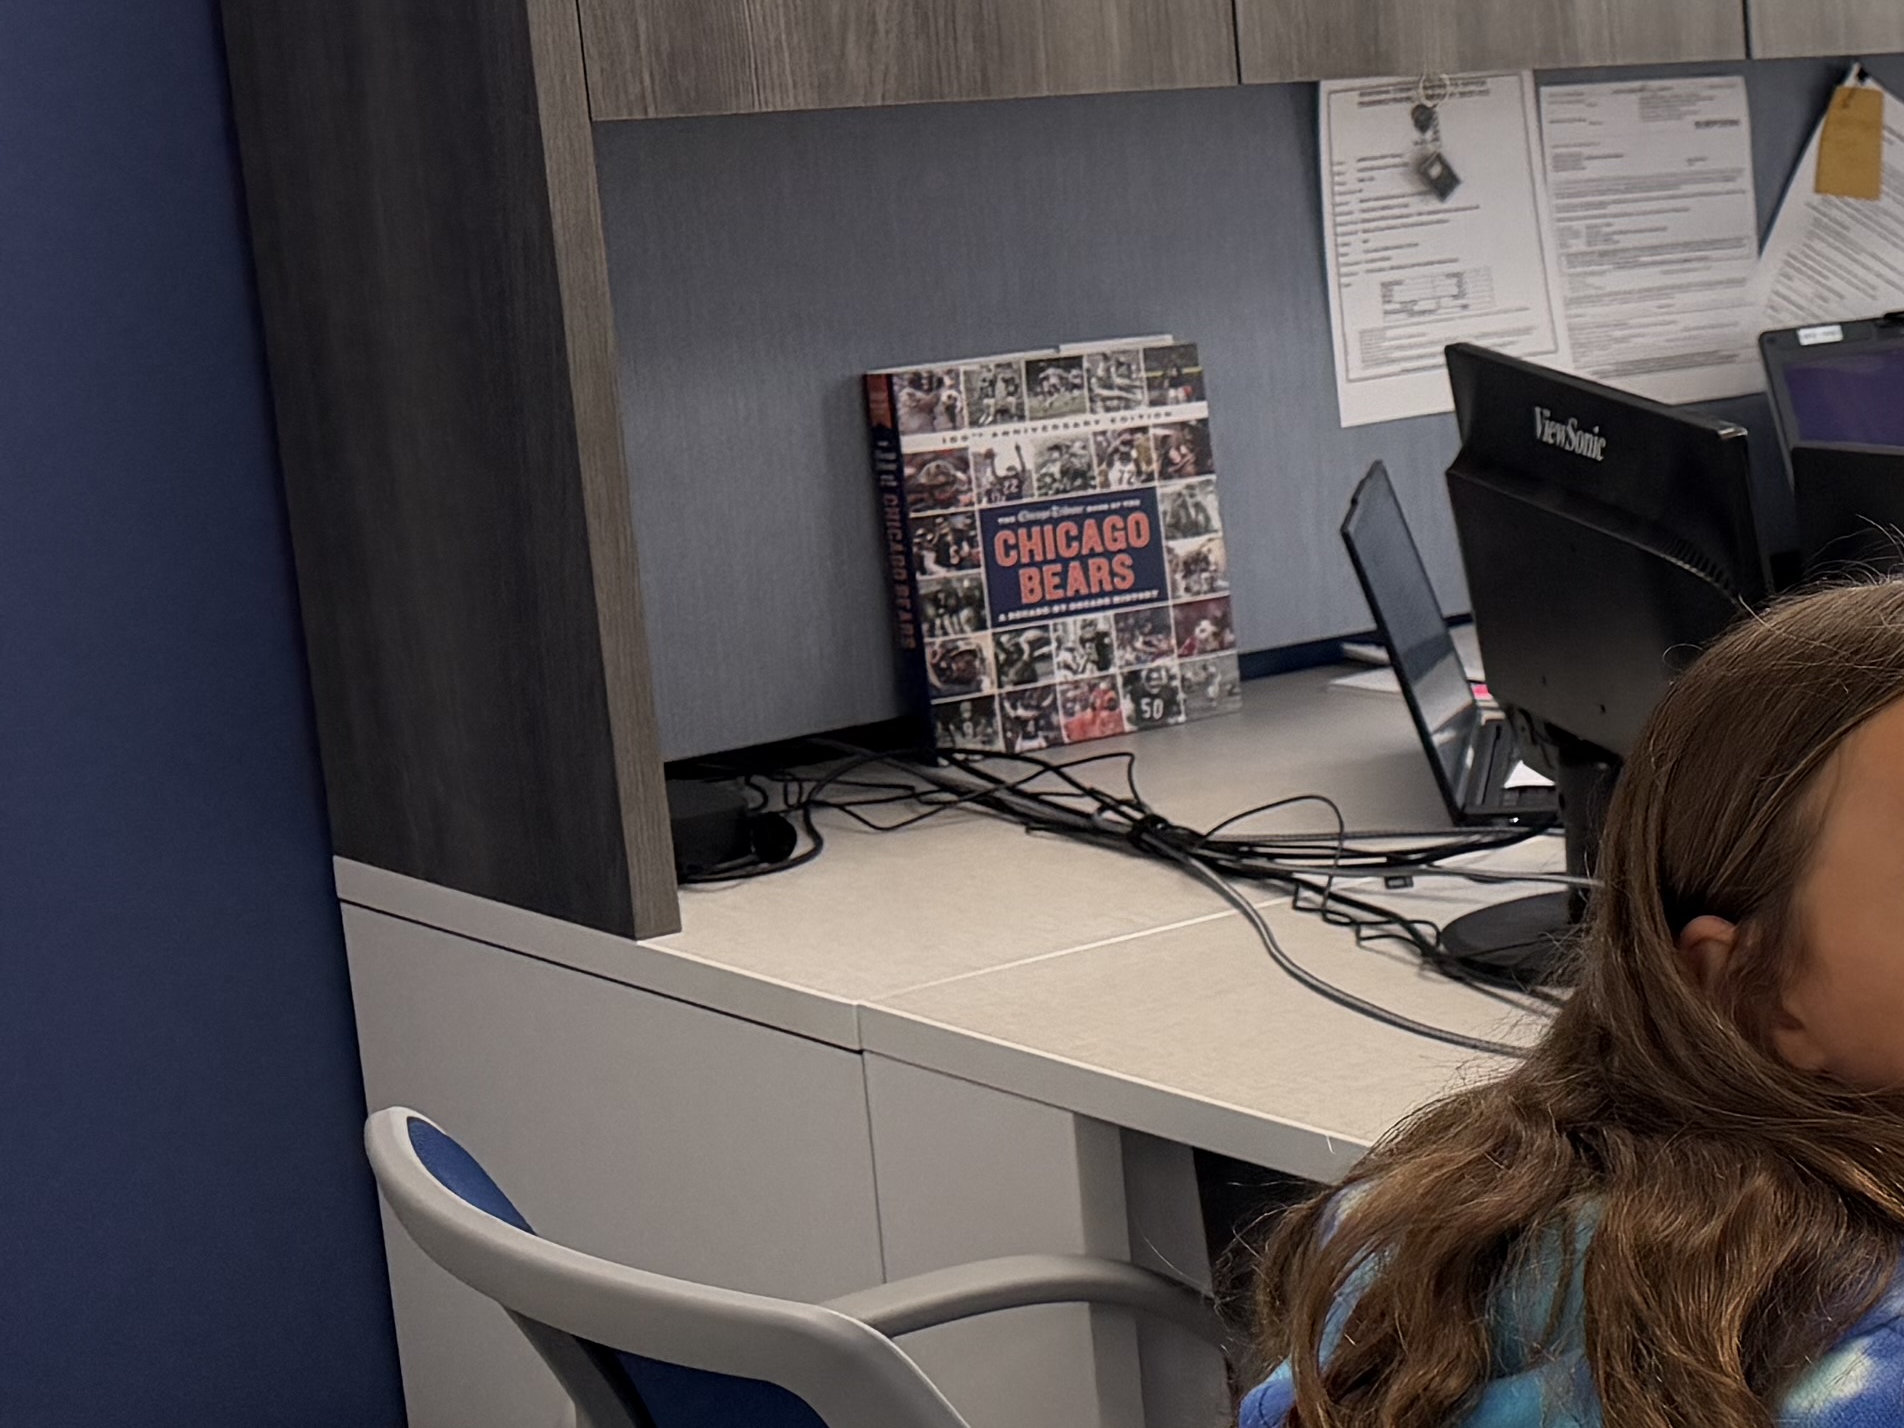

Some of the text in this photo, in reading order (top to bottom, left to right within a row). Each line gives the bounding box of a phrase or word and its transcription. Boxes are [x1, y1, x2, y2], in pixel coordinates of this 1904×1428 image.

[1533, 406, 1607, 462] ViewSonic
[994, 511, 1151, 567] CHICAGO
[1019, 553, 1135, 605] BEARS
